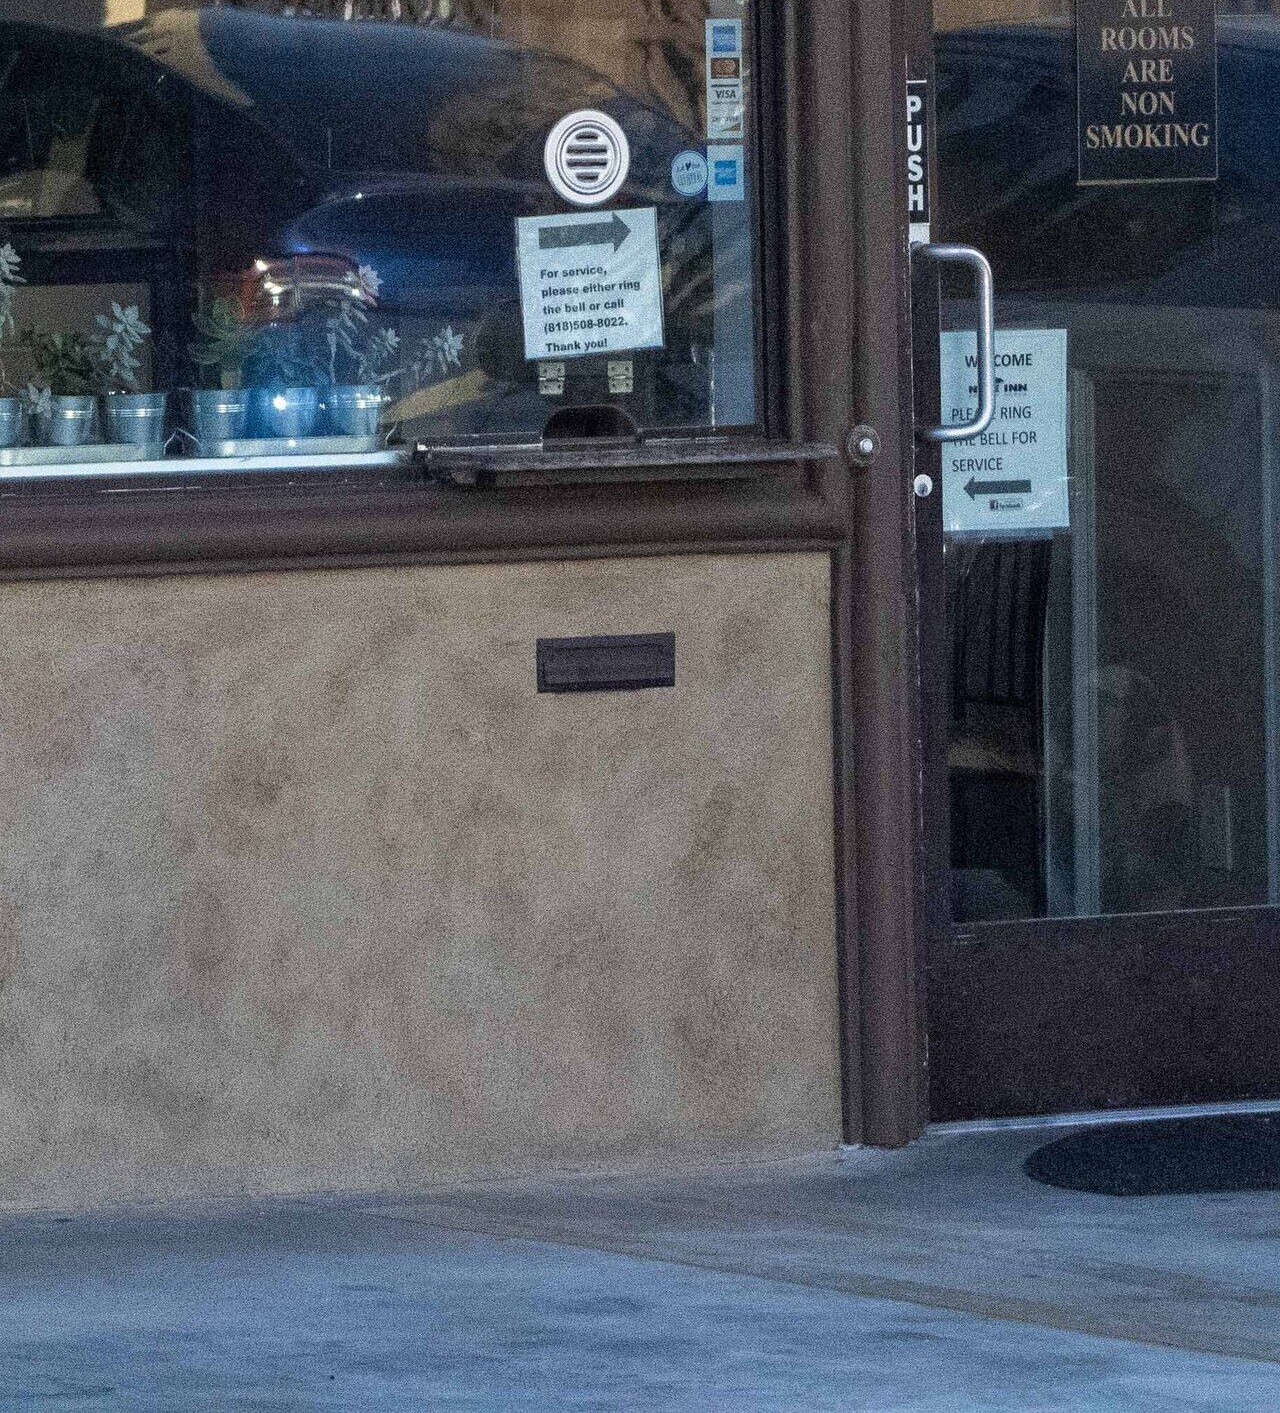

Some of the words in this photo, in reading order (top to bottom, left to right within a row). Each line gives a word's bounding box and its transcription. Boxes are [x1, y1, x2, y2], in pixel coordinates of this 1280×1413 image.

[1100, 26, 1195, 52] ROOMS
[1122, 59, 1174, 83] ARE
[715, 89, 737, 99] VISA
[1120, 91, 1176, 116] NON
[1085, 122, 1210, 149] SMOKING
[906, 95, 924, 211] PUSH
[540, 268, 559, 279] For
[562, 265, 607, 278] service,
[541, 285, 579, 299] please
[582, 282, 616, 293] either
[618, 280, 641, 292] ring
[543, 303, 562, 315] the
[564, 301, 586, 313] bell
[589, 303, 601, 311] or
[604, 298, 624, 310] call
[545, 340, 581, 352] Thank
[584, 338, 608, 352] you!
[965, 353, 1033, 368] WCOME
[1003, 383, 1028, 393] INN
[1000, 406, 1032, 420] RING
[980, 432, 1008, 446] BELL
[1012, 431, 1038, 444] FOR
[952, 457, 1004, 473] SERVICE
